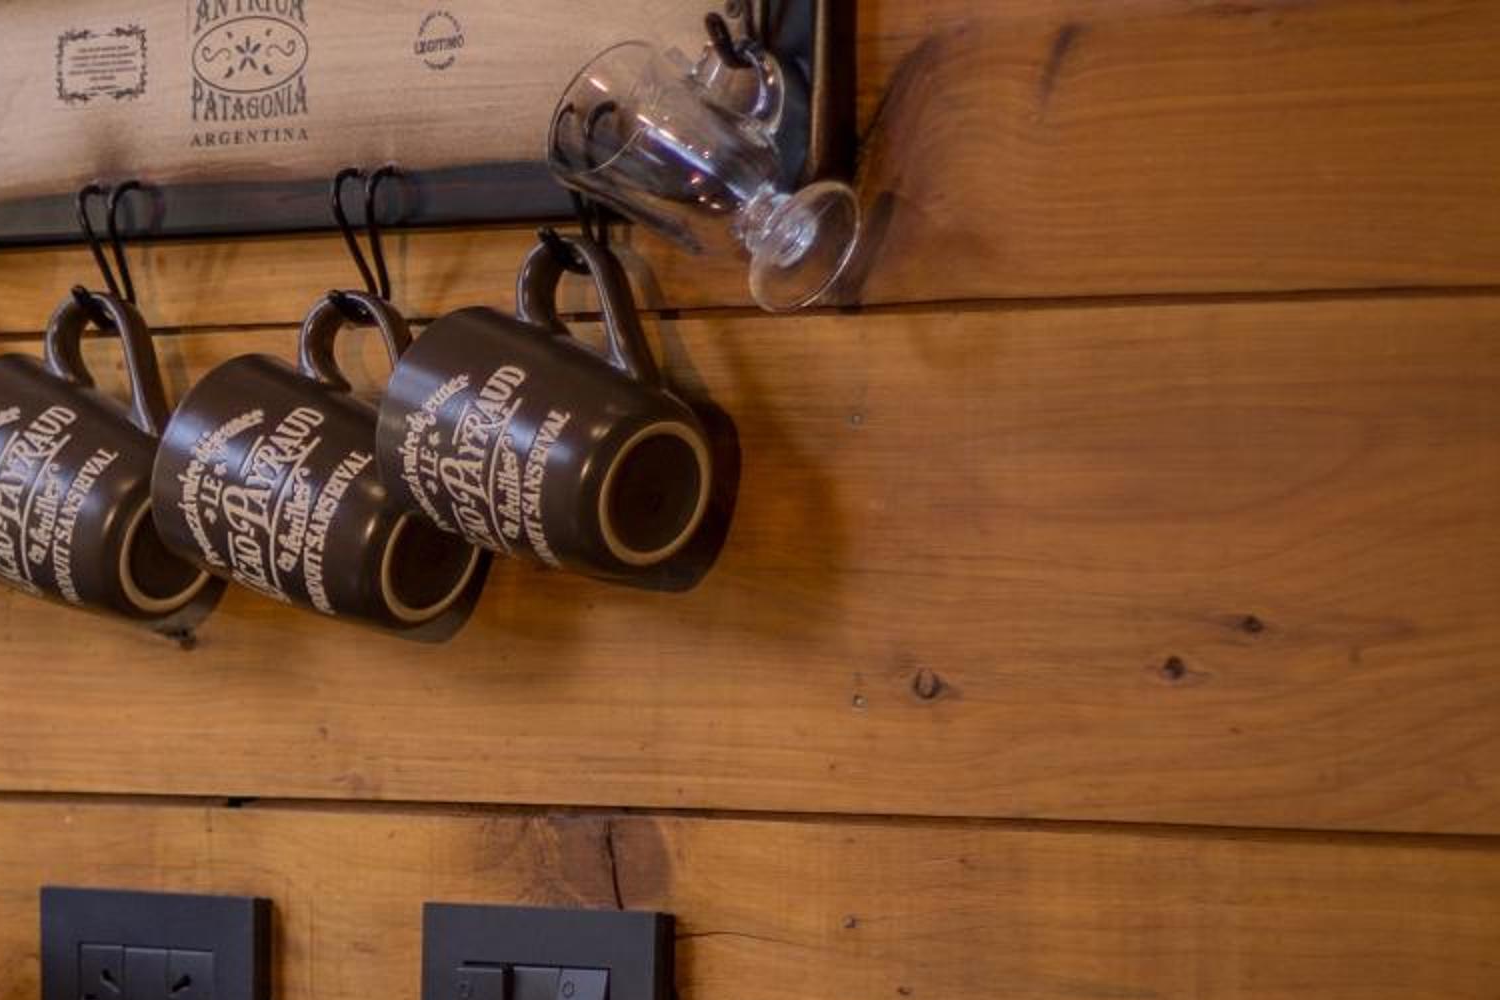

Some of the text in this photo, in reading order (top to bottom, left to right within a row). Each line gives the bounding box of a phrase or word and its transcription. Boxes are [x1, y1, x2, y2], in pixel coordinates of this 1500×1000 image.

[191, 77, 308, 121] PATAGONIA
[190, 128, 309, 147] ARGENTINA
[320, 451, 373, 500] RIVAL
[420, 447, 440, 477] LE
[56, 491, 86, 545] SANS
[72, 448, 119, 497] RIVAL
[200, 474, 223, 508] LE
[522, 466, 545, 519] SANS
[305, 492, 340, 551] SANS
